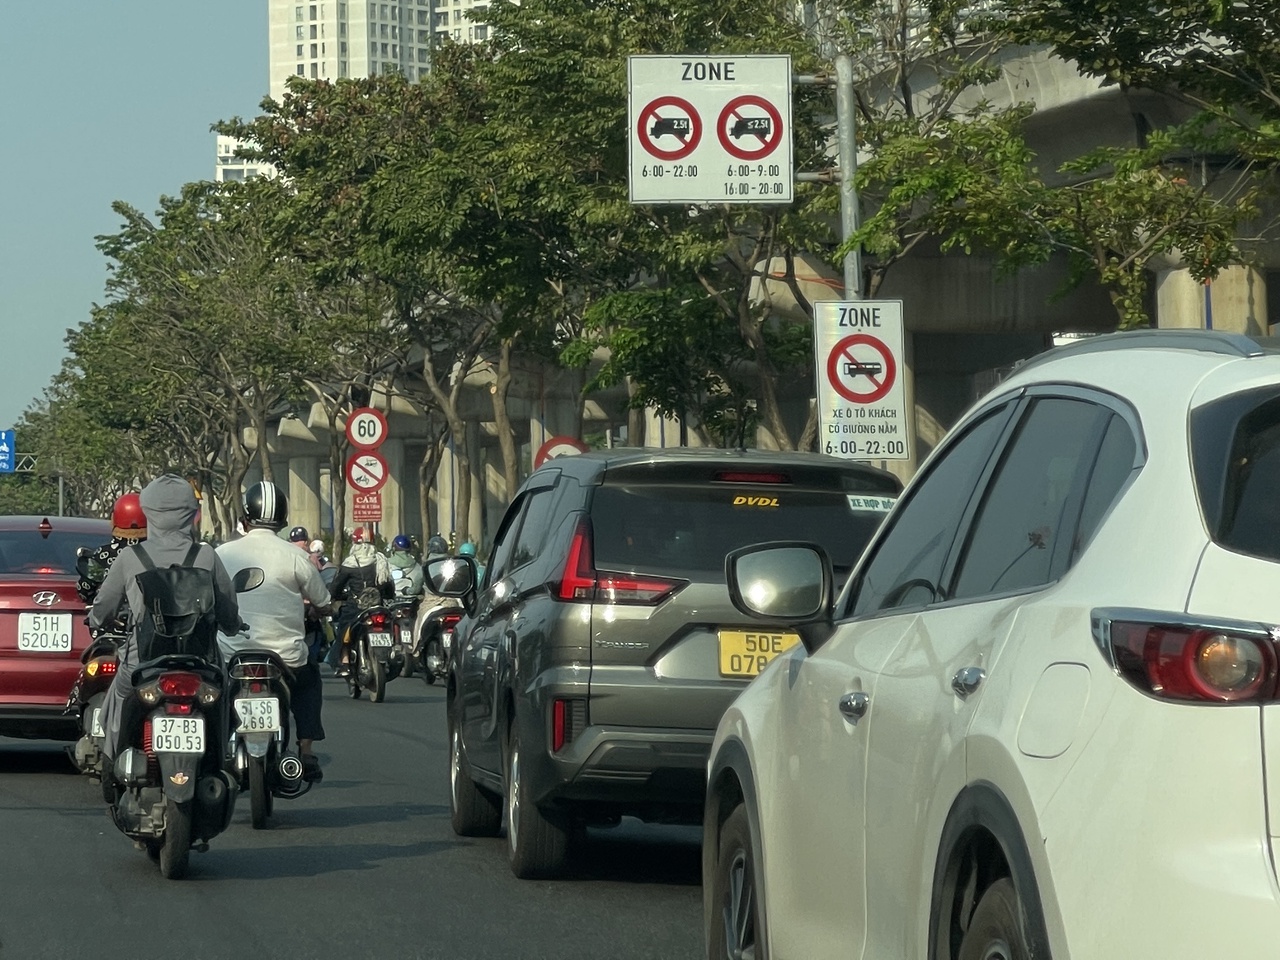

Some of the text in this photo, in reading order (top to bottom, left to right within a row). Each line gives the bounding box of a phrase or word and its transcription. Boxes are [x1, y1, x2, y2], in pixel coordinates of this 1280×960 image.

[682, 62, 736, 81] ZONE
[838, 308, 882, 328] ZONE
[832, 409, 843, 418] XE
[868, 406, 897, 418] KHÁCH
[358, 419, 376, 438] 60
[828, 422, 840, 434] CÓ
[733, 496, 780, 507] DVDL
[850, 498, 863, 507] XE
[32, 616, 59, 632] 51H
[22, 632, 69, 648] 520.49
[745, 634, 783, 653] 50E
[161, 719, 197, 734] 37-B3
[156, 734, 202, 750] 050.53
